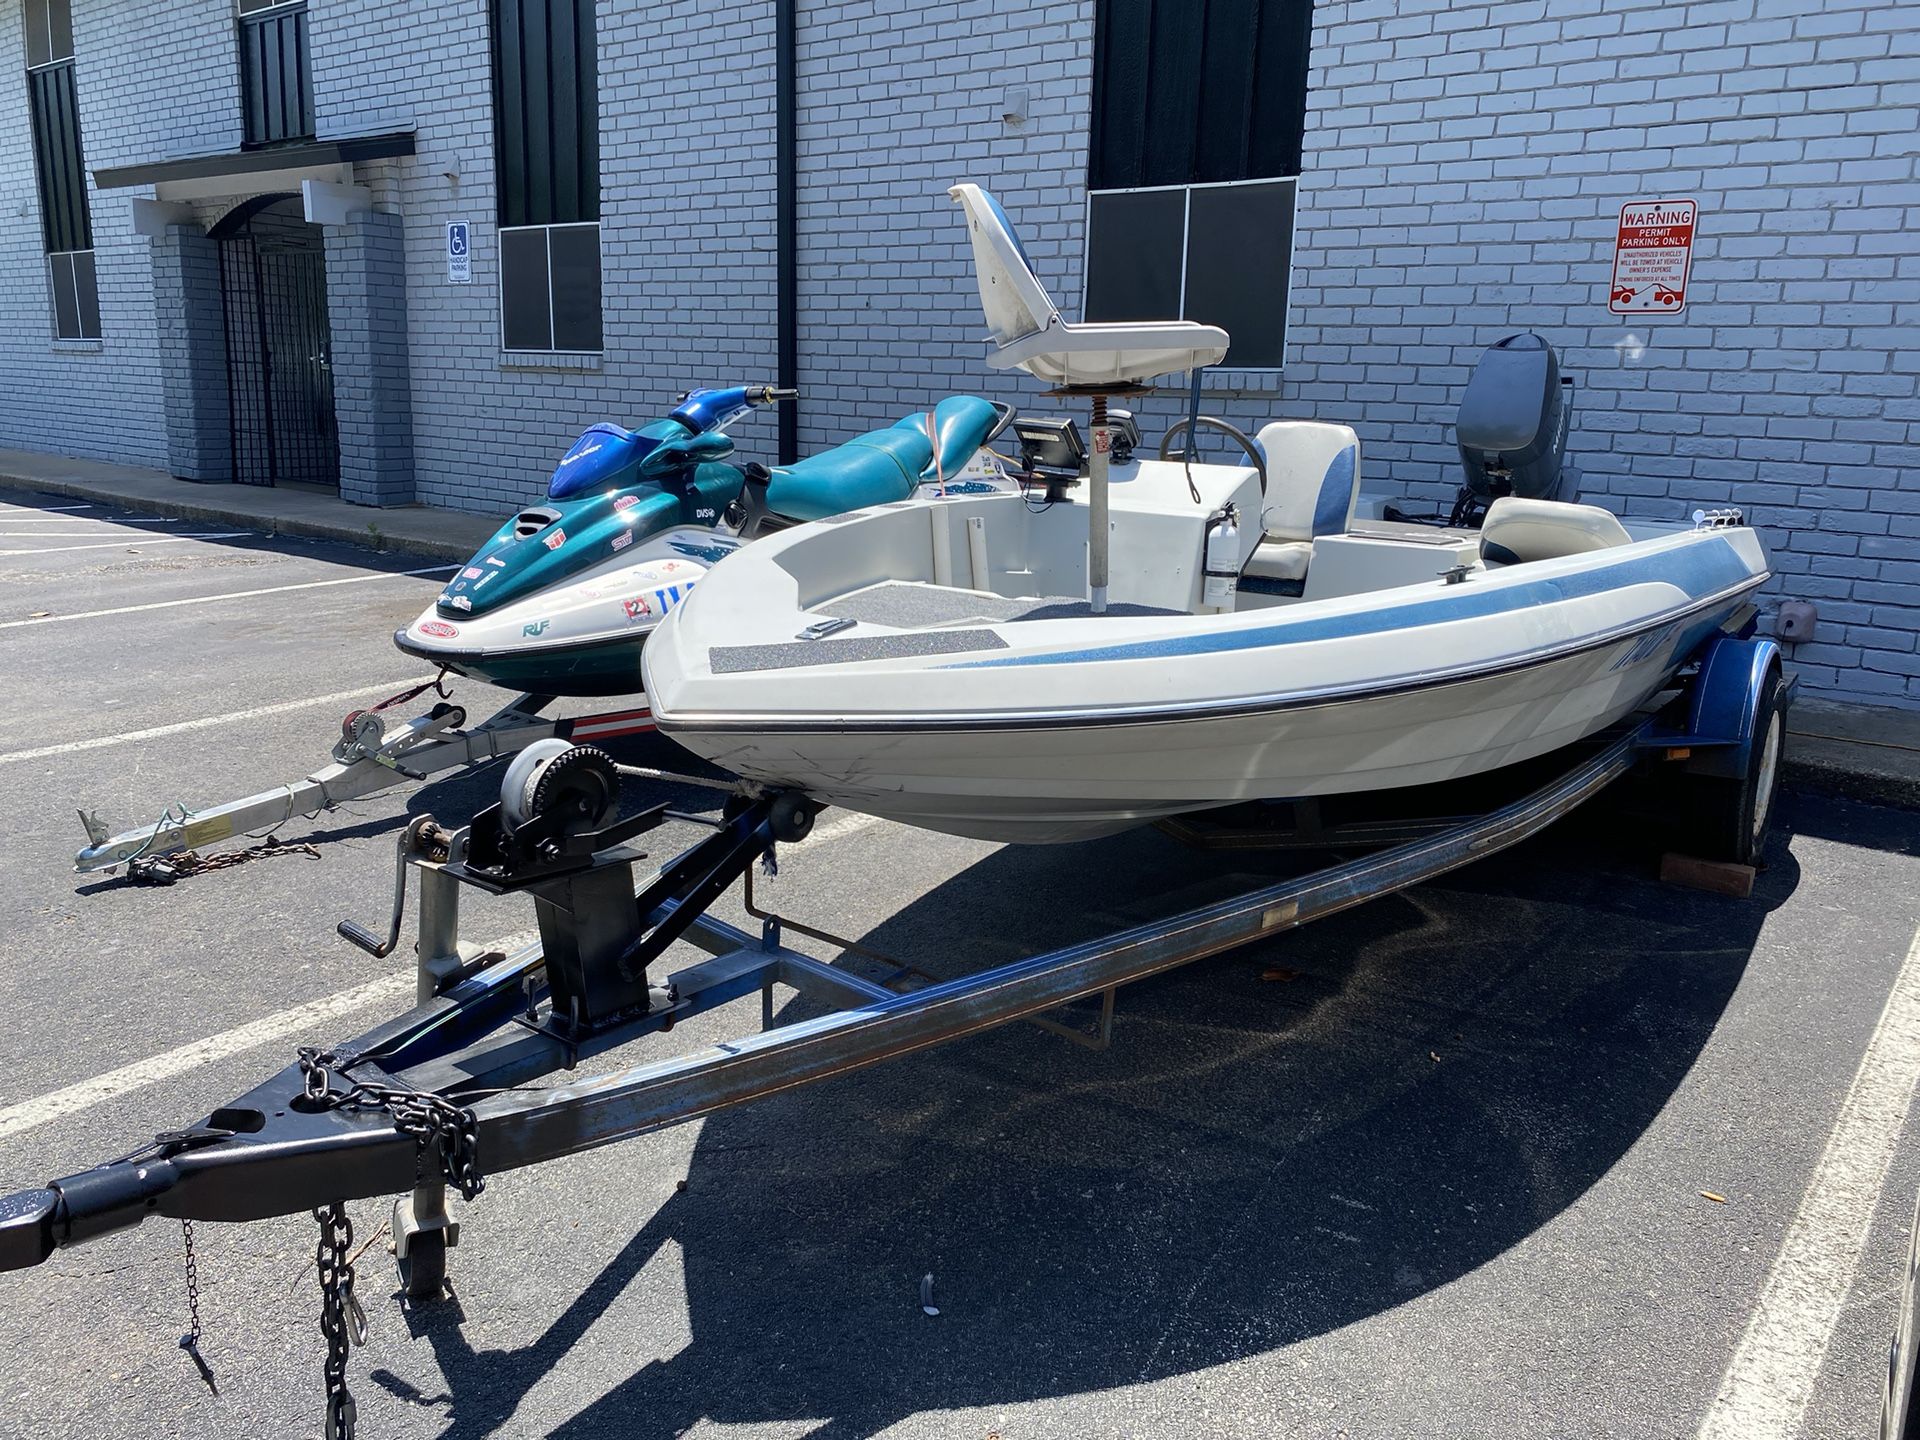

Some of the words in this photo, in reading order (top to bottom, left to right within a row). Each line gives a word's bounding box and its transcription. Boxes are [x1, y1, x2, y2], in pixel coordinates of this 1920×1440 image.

[1625, 211, 1690, 226] WARNING
[1639, 228, 1671, 237] PERMIT
[1621, 237, 1660, 247] PARKING
[1662, 236, 1687, 246] ONLY
[1659, 250, 1682, 258] VEHICLES
[696, 508, 709, 518] DVS
